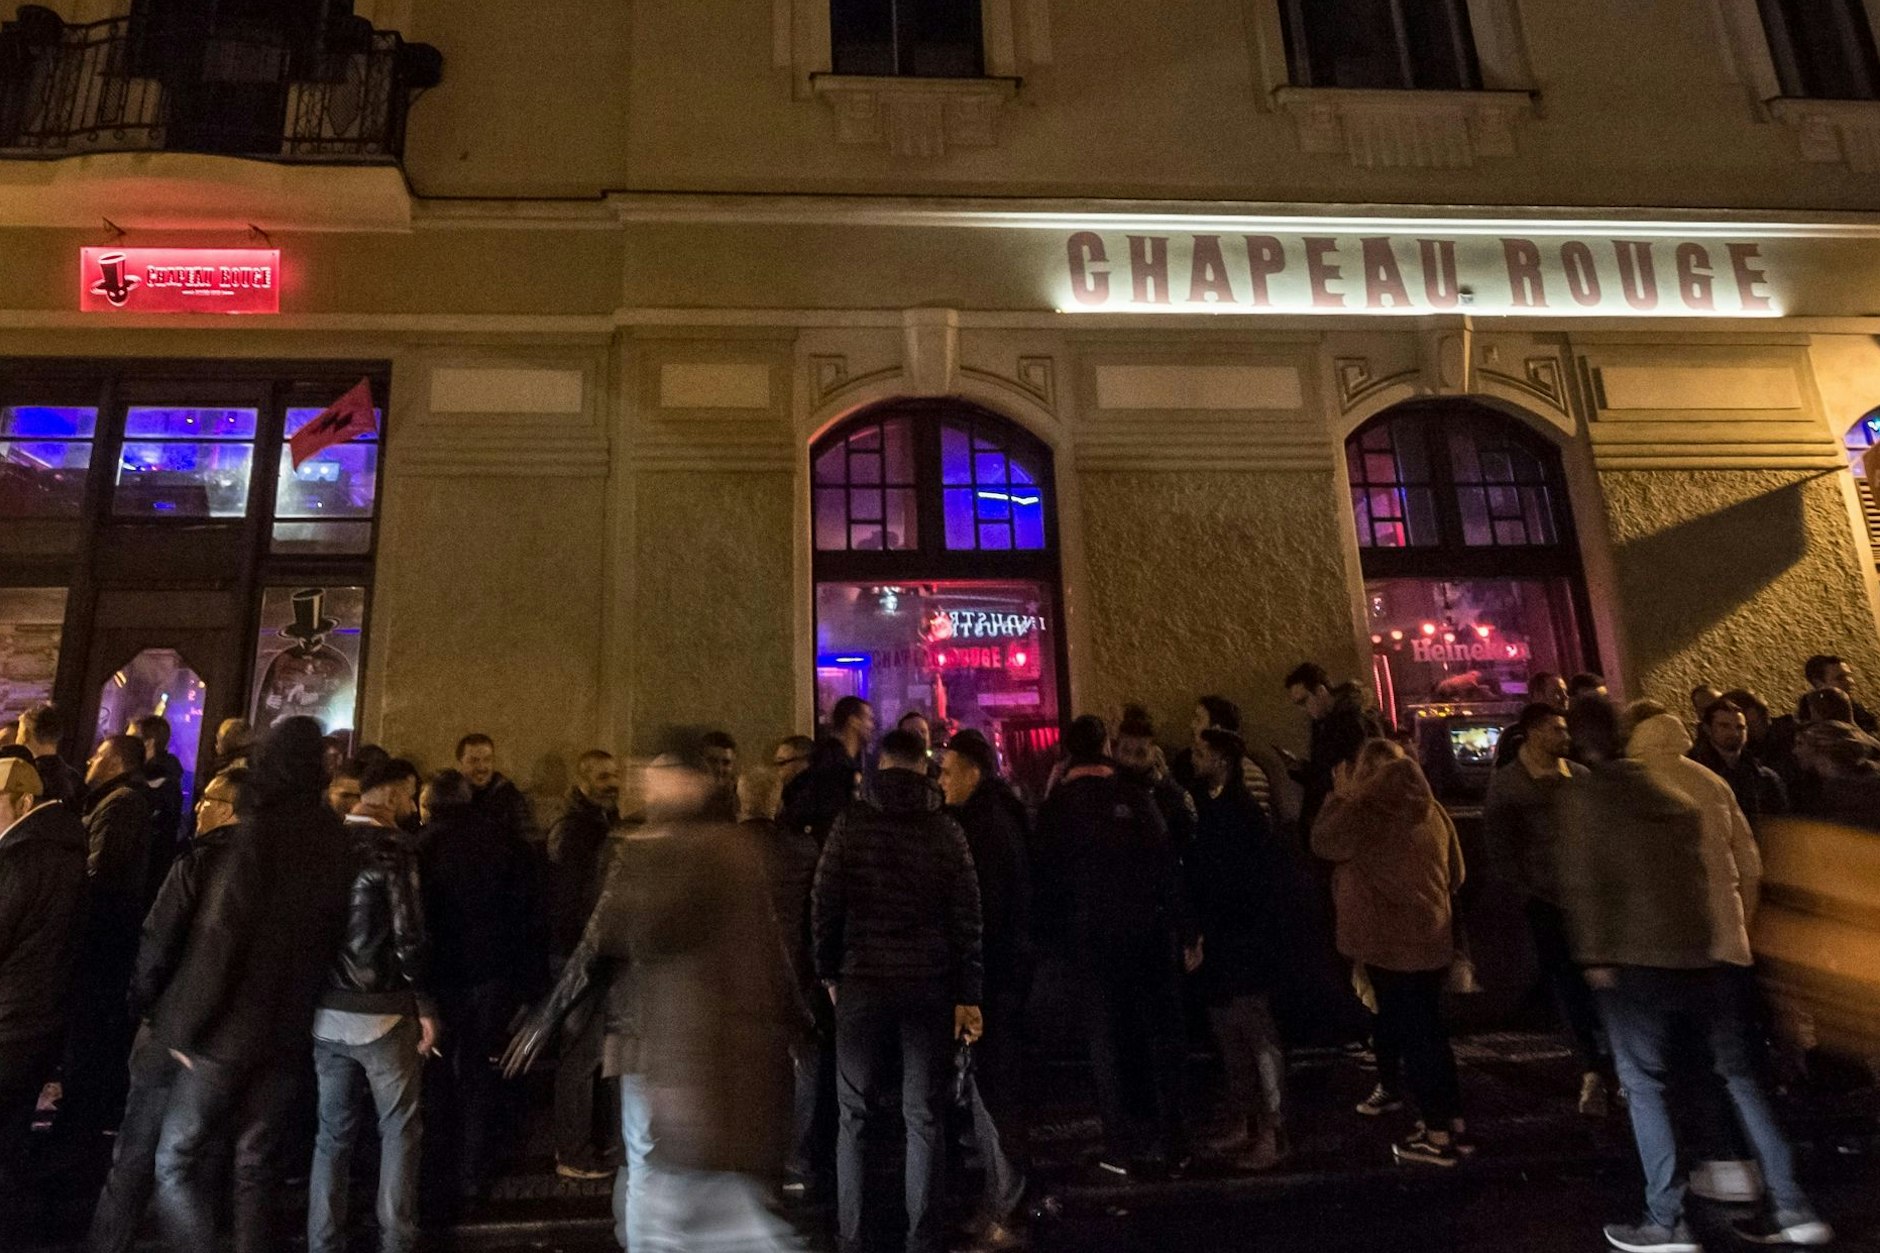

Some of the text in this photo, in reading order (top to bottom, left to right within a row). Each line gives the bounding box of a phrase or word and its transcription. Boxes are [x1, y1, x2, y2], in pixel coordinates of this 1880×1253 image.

[146, 265, 272, 289] CHAPEAU ROUGE
[1067, 231, 1773, 311] CHAPEAU ROUGE
